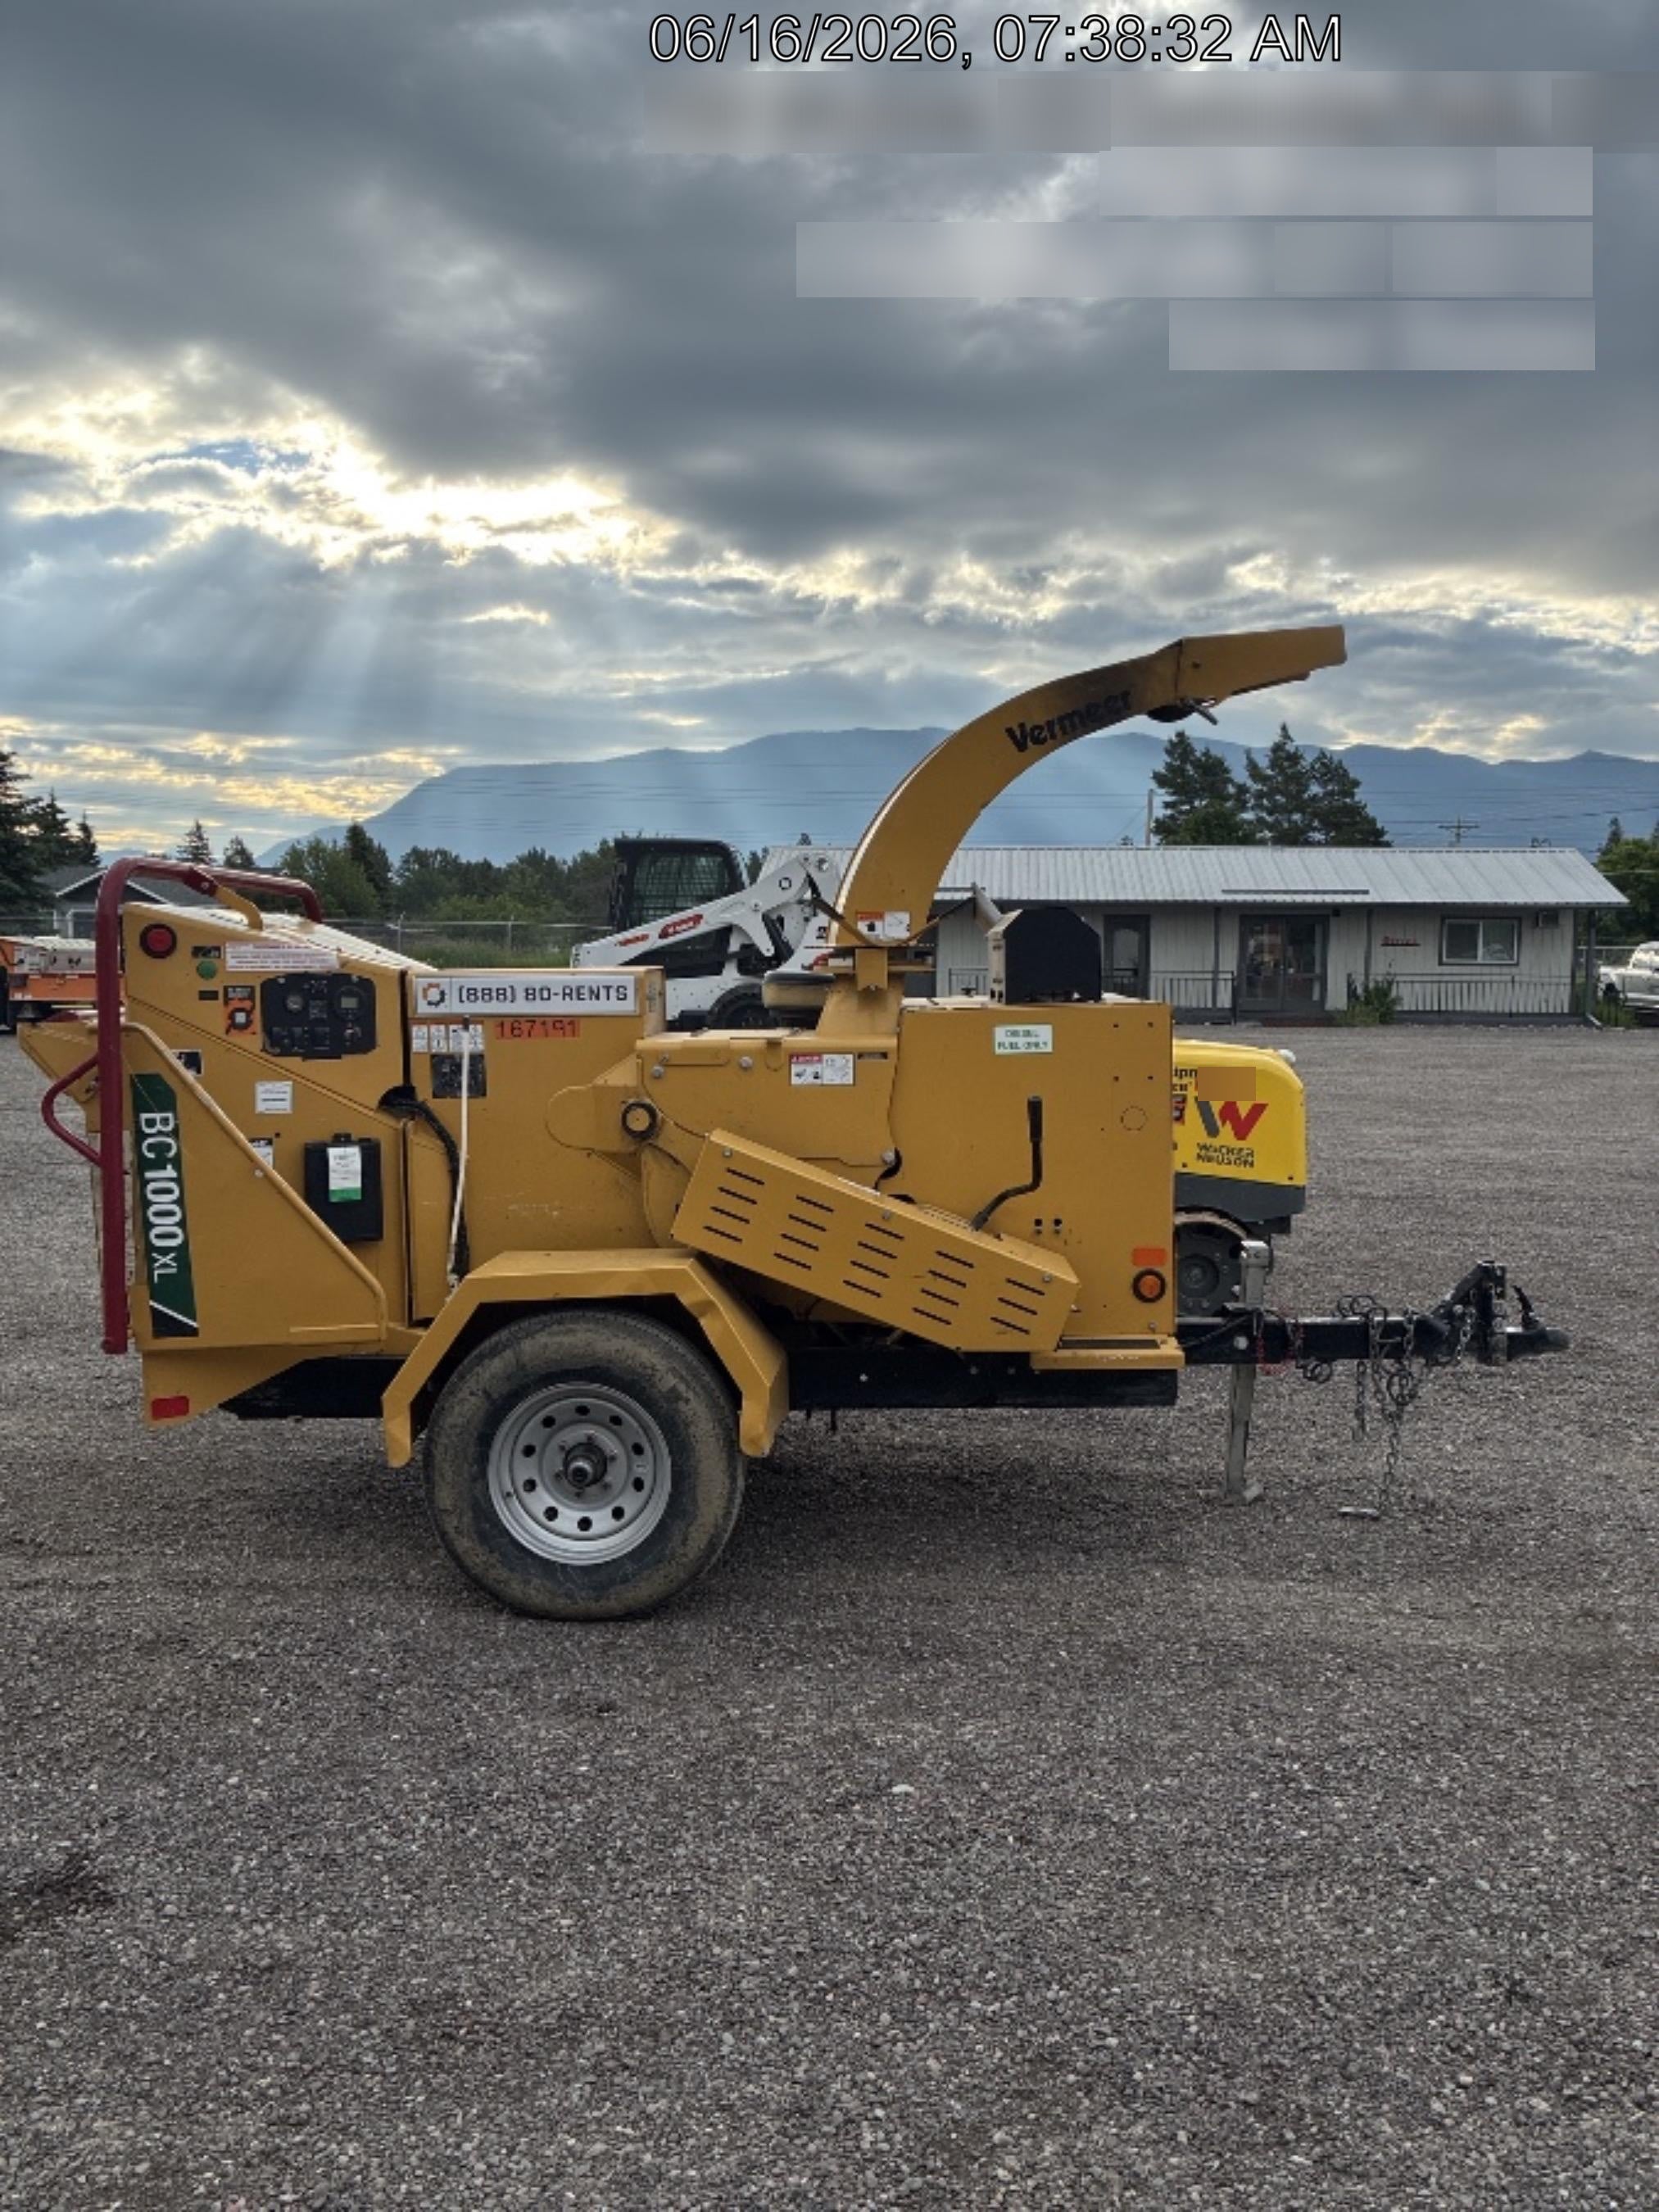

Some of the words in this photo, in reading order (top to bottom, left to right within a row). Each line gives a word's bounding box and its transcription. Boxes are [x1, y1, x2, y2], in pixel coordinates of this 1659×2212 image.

[1005, 690, 1131, 753] Vermeer
[458, 985, 516, 1004] (888)
[496, 1020, 577, 1038] 167191
